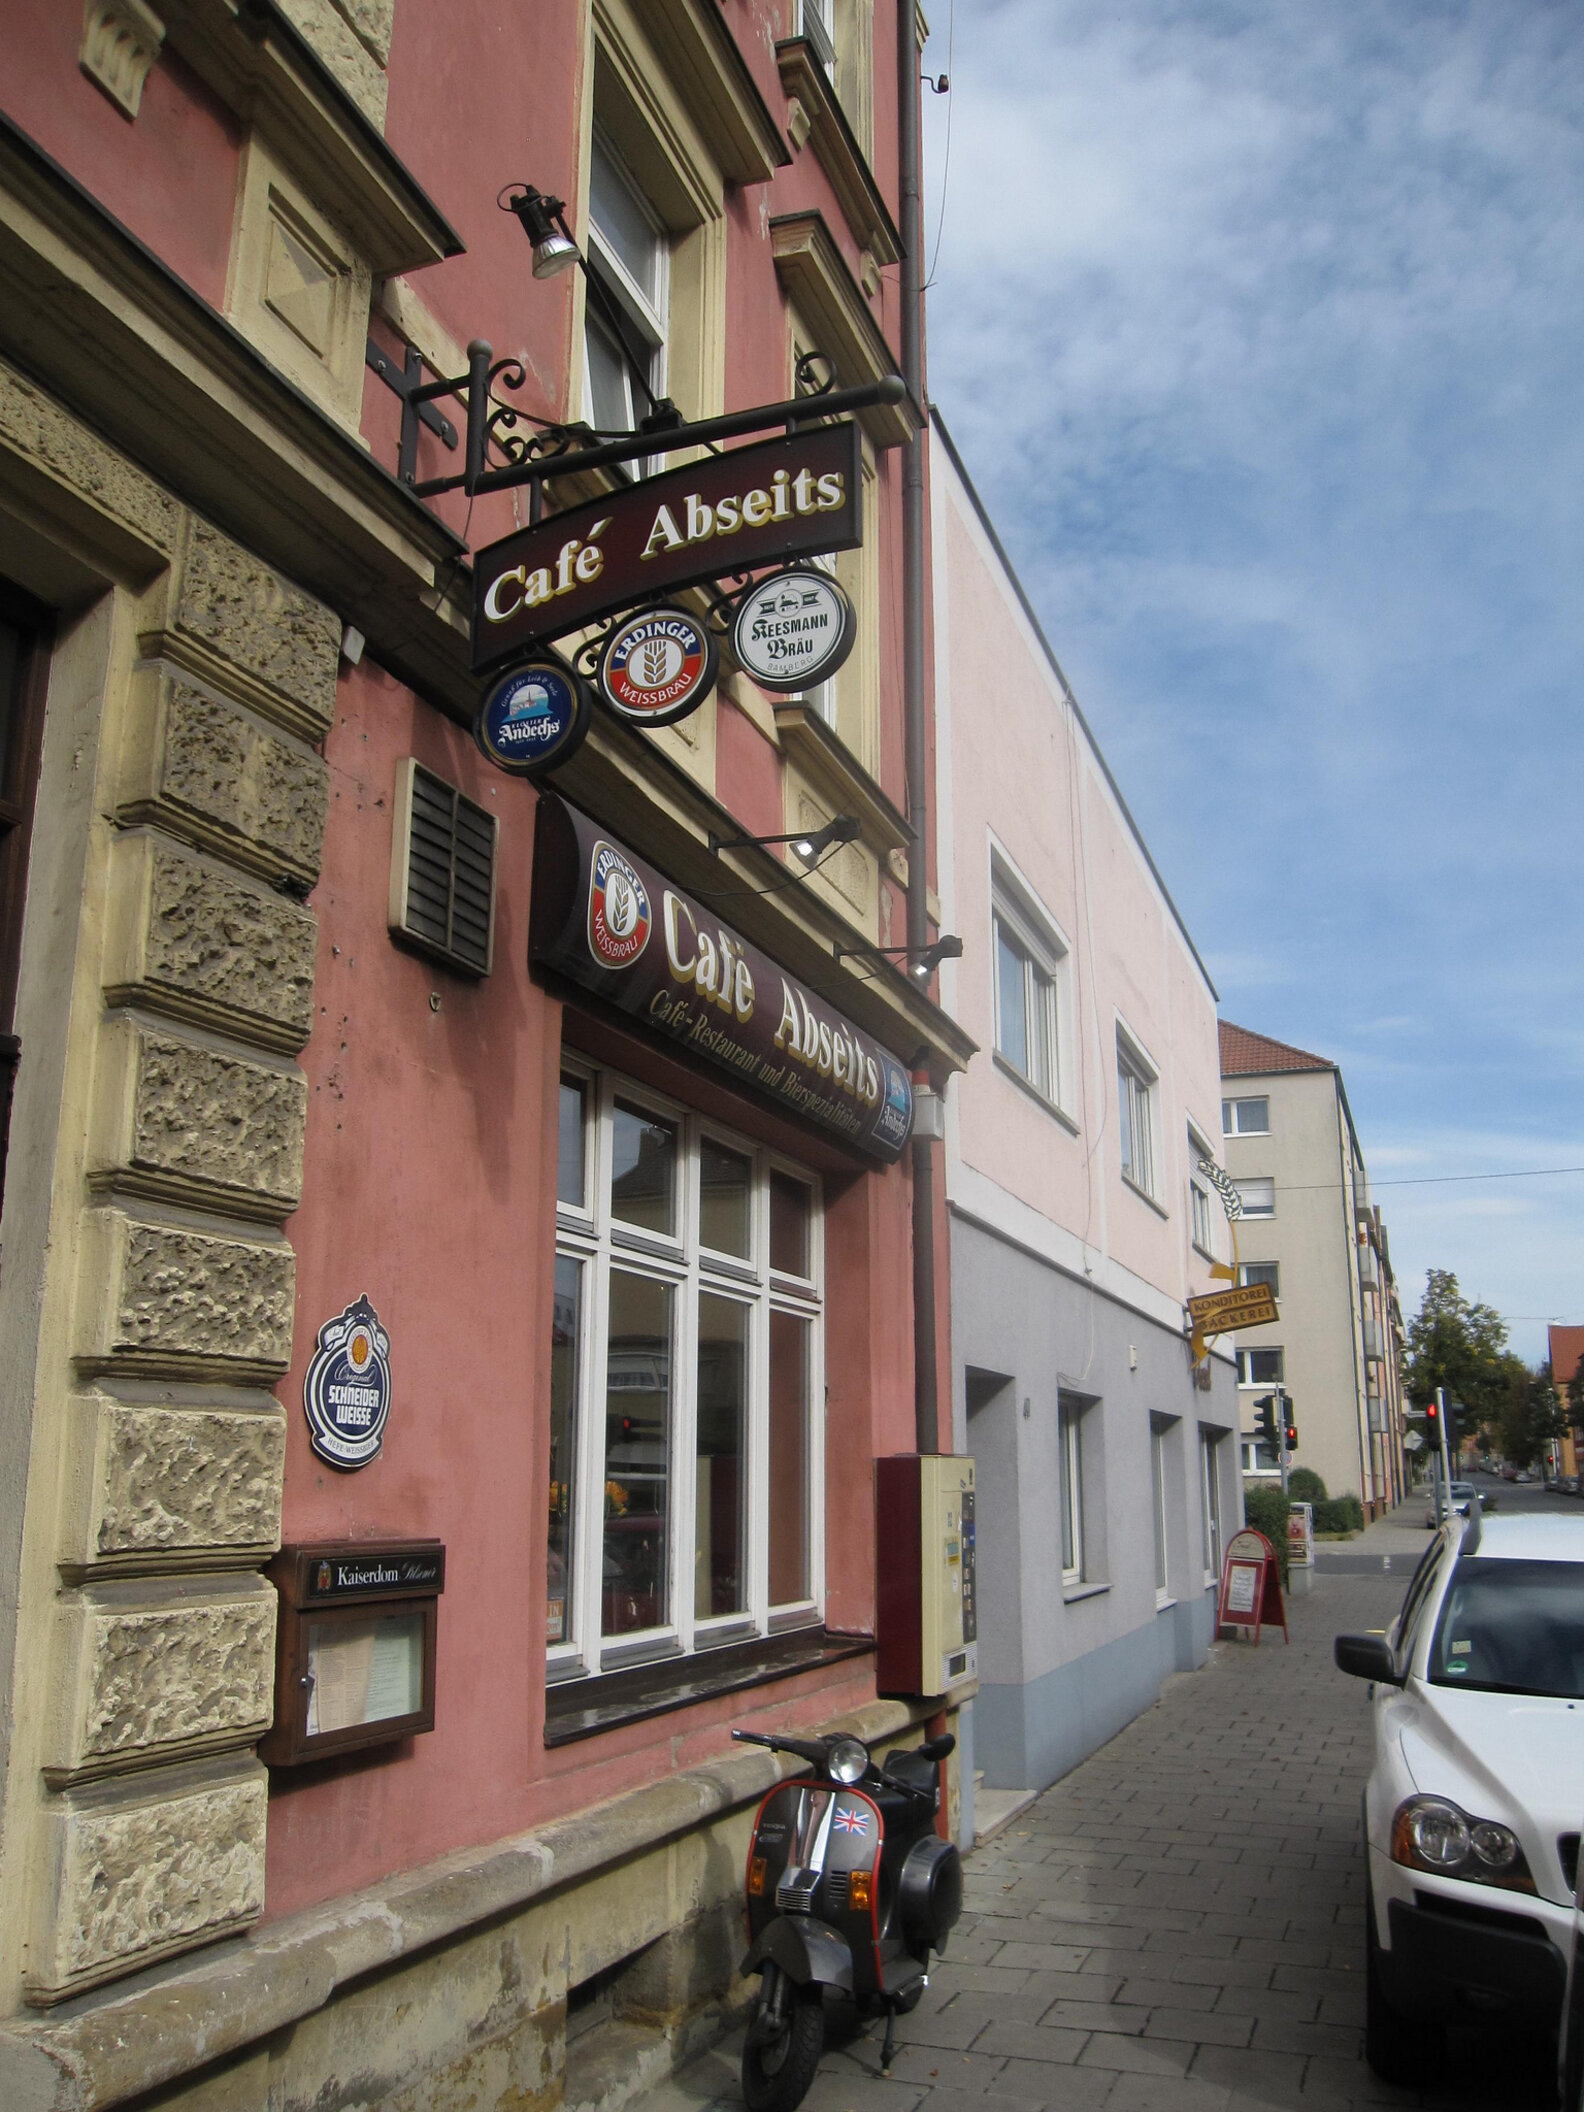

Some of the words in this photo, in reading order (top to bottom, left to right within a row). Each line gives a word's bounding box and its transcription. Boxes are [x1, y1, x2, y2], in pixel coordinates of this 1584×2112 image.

[483, 517, 614, 624] Café
[640, 467, 846, 562] Abseits
[614, 621, 697, 660] ERDINGER
[751, 613, 828, 642] KEESMANN
[766, 655, 814, 672] BAMBERG
[619, 672, 692, 705] WEISSBRÄU
[497, 715, 560, 748] Andechs
[597, 850, 646, 905] ERDINGER
[774, 976, 880, 1109] Abseits
[757, 1063, 786, 1087] und
[1193, 1286, 1269, 1313] KONDITOREI
[328, 1384, 380, 1408] SCHNEIDER
[335, 1404, 373, 1426] WEISSE
[337, 1564, 399, 1586] Kaiserdom
